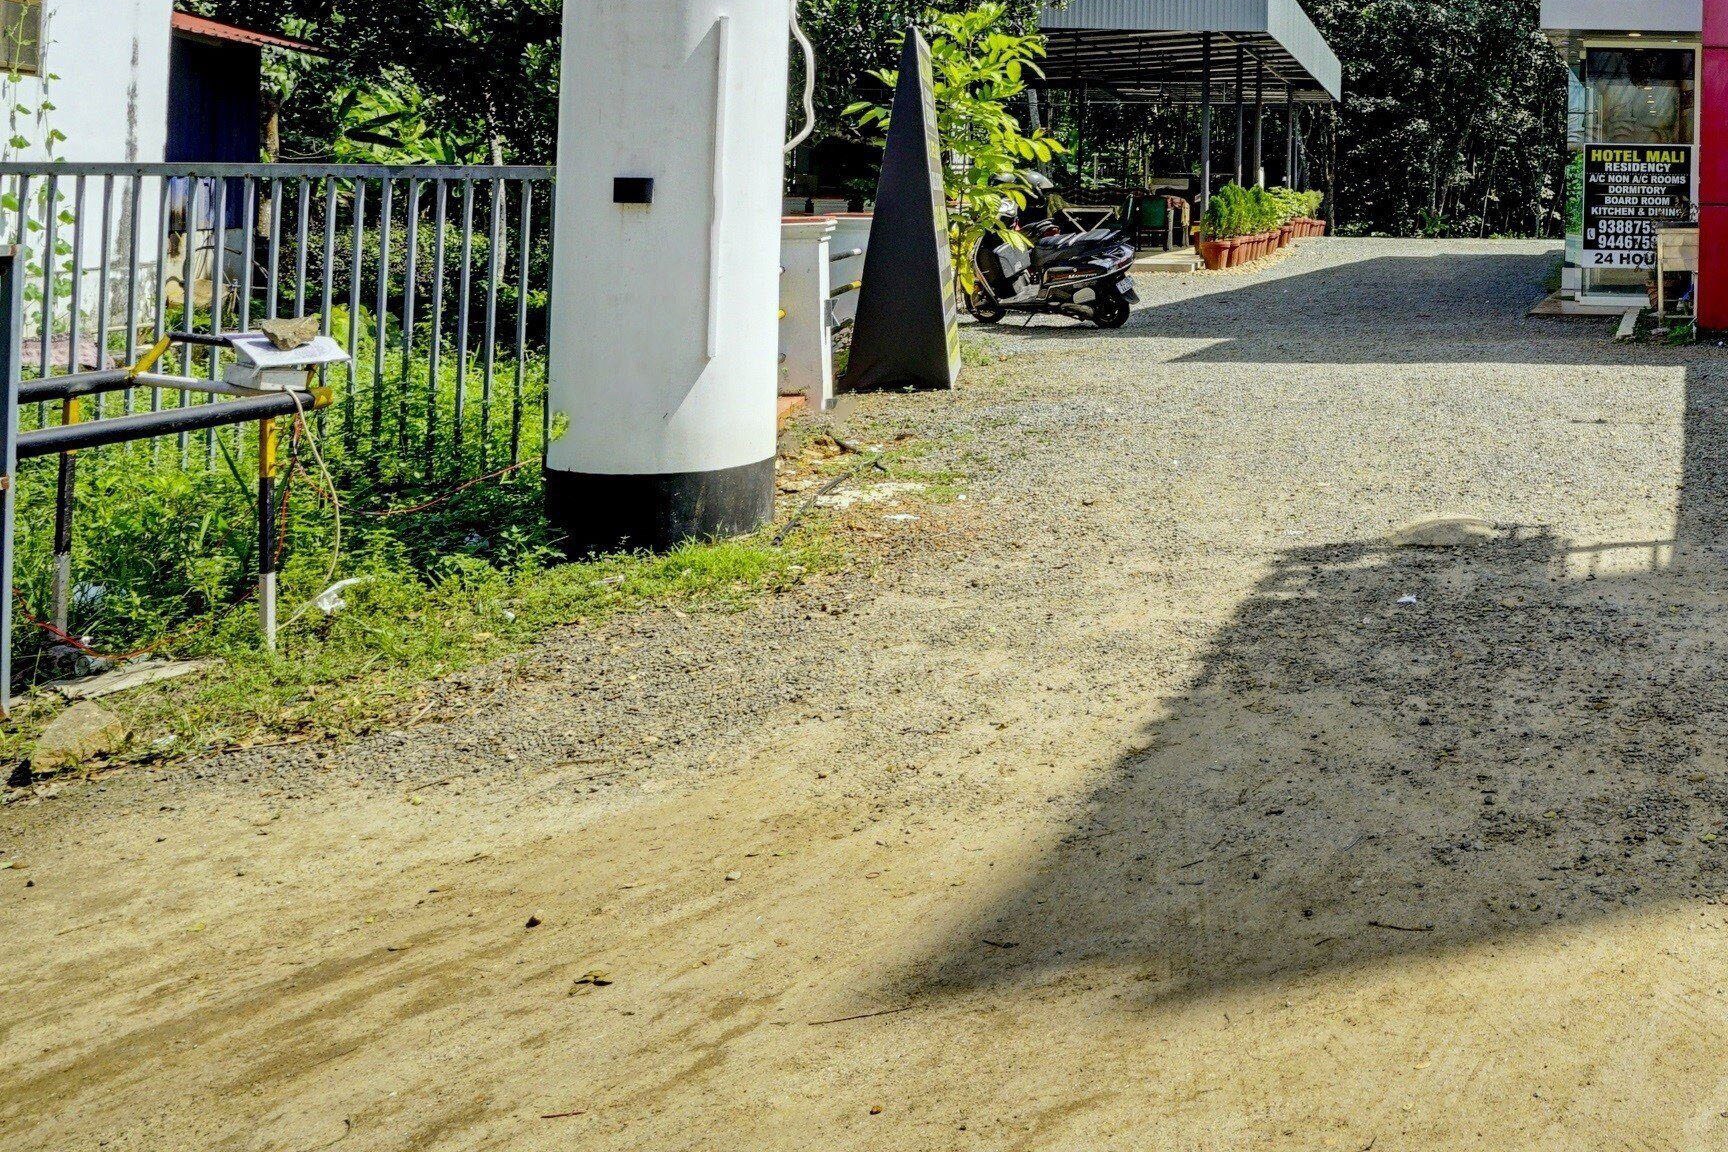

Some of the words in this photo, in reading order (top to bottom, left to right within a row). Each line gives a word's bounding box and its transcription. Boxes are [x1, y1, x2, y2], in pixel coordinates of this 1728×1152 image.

[1591, 149, 1641, 162] HOTEL
[1645, 150, 1685, 163] MALI
[1604, 162, 1672, 173] RESIDENCY
[1589, 174, 1605, 183] A/C
[1608, 175, 1629, 183] NON
[1632, 175, 1648, 184] A/C
[1650, 175, 1687, 185] ROOMS
[1608, 185, 1667, 195] DORMITORY
[1604, 196, 1639, 205] BOARD
[1641, 197, 1670, 206] ROOM
[1591, 207, 1635, 216] KITCHEN
[1637, 207, 1645, 216] &
[1598, 219, 1657, 234] 938875
[1594, 252, 1614, 264] 24
[1619, 252, 1656, 265] HOU
